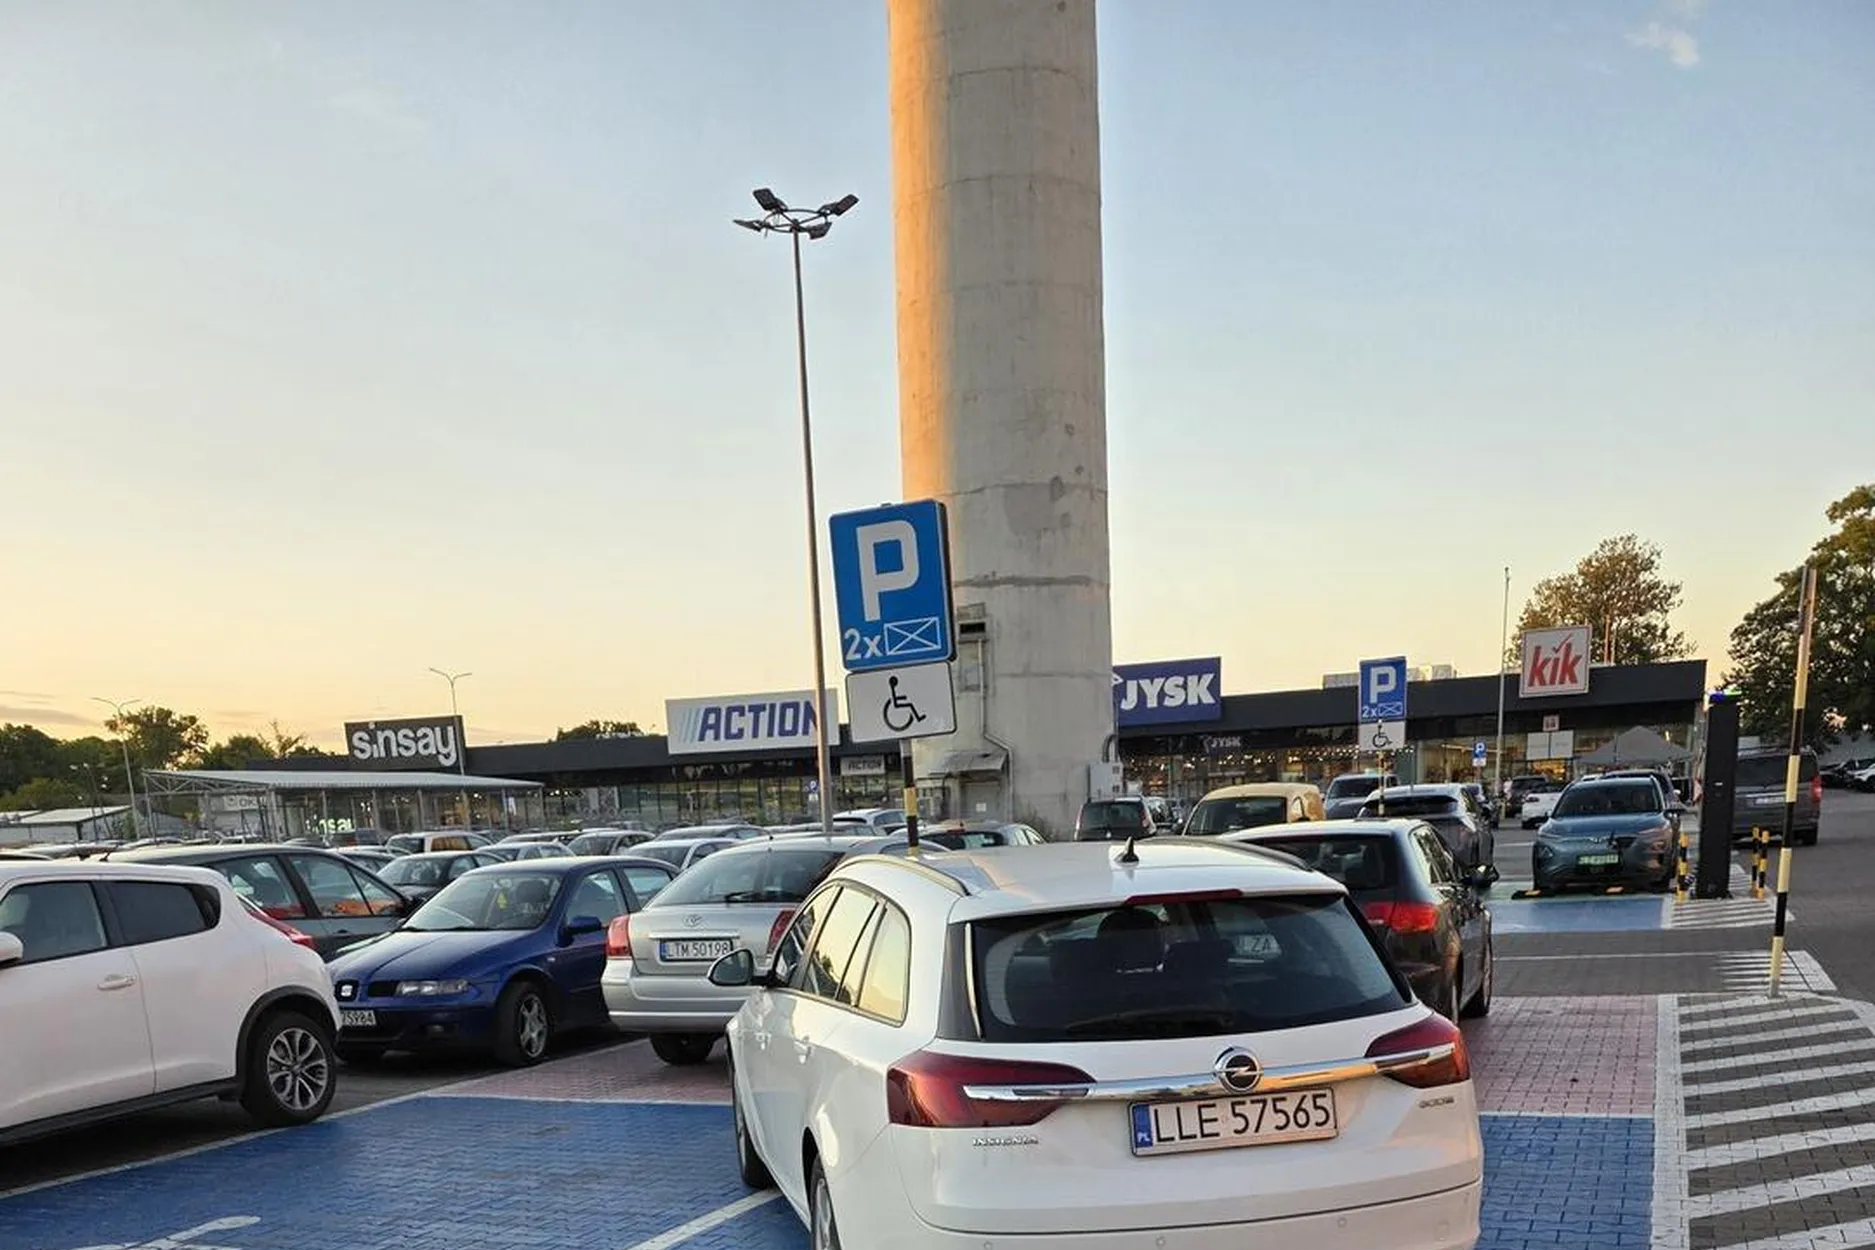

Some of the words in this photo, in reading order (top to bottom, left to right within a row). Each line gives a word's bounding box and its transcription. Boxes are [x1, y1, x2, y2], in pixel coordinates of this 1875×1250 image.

[856, 519, 920, 622] P
[844, 628, 884, 661] 2x
[1528, 634, 1582, 687] kik
[1120, 673, 1216, 711] JYSK
[1369, 665, 1397, 704] P
[698, 700, 820, 742] ACTION
[1362, 705, 1378, 718] 2x
[351, 721, 457, 767] sinsay
[692, 942, 729, 957] 50198
[1154, 1103, 1220, 1143] LLE
[1230, 1092, 1331, 1135] 57565
